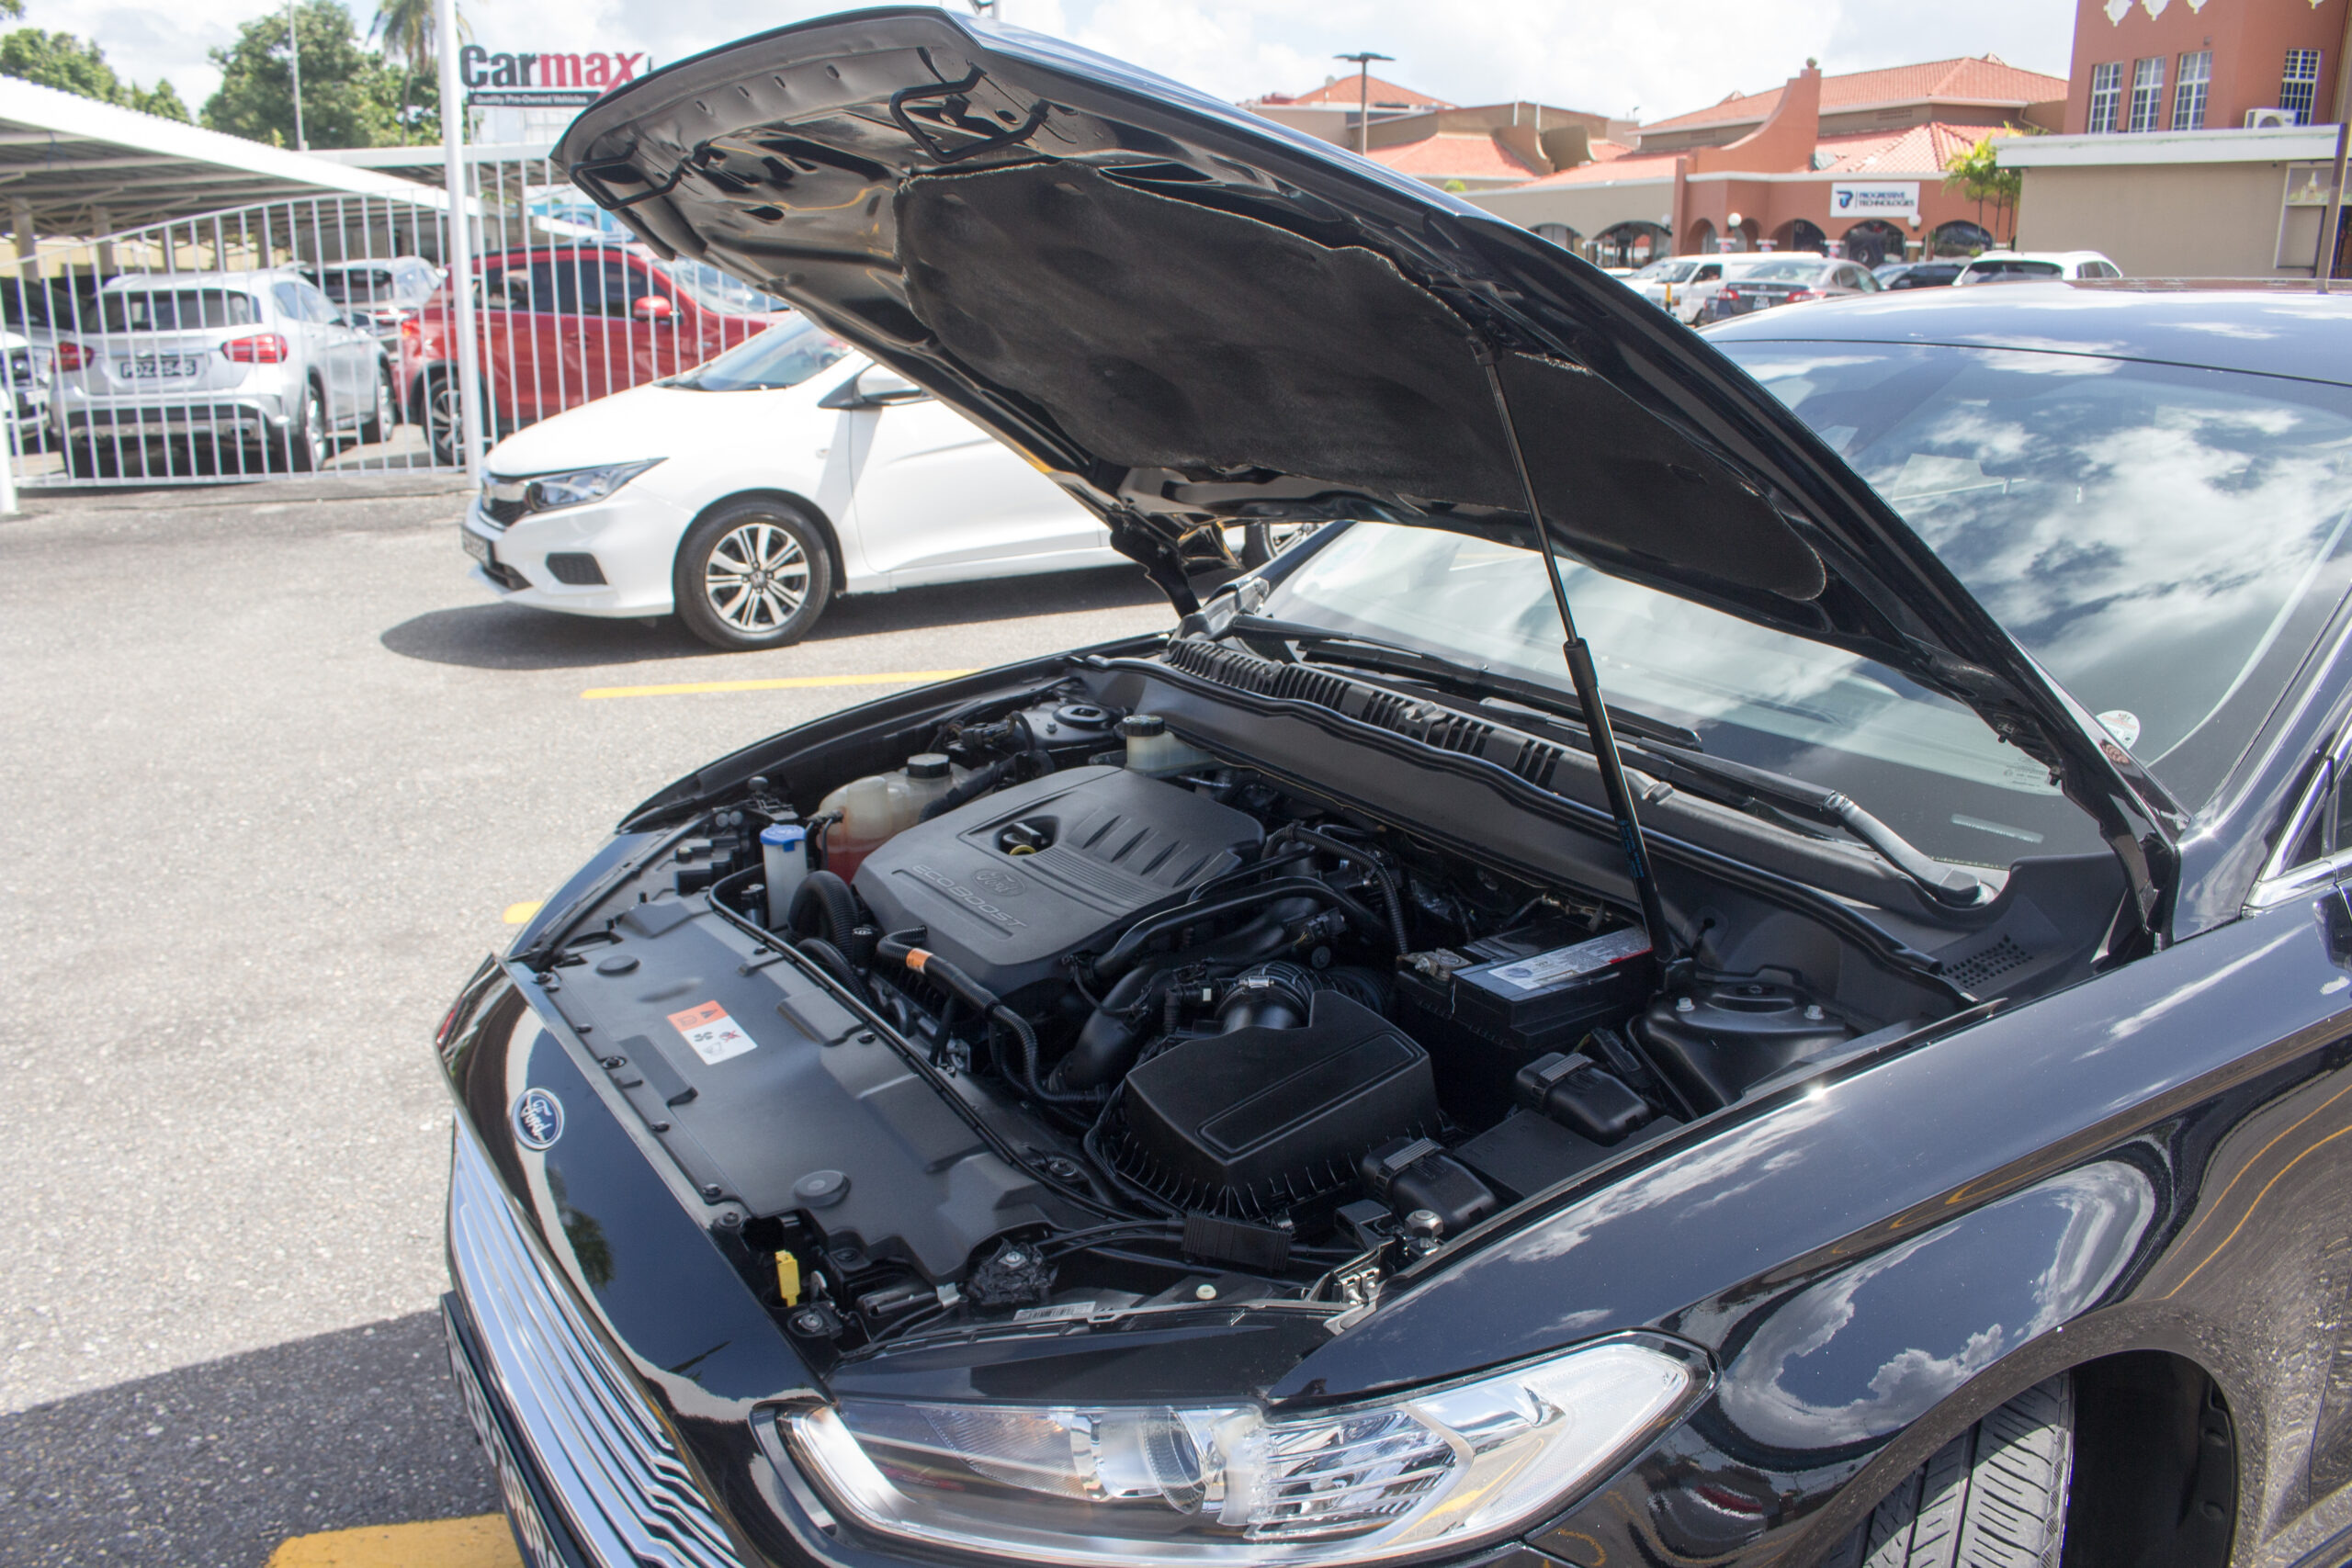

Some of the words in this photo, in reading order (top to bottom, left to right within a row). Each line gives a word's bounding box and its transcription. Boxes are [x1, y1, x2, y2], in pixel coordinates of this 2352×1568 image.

[459, 45, 645, 99] Carmax
[553, 94, 589, 104] Vehicles
[1859, 199, 1915, 208] TECHNOLOGIES
[912, 864, 1027, 928] ECOBOOST
[521, 1094, 553, 1141] Ford
